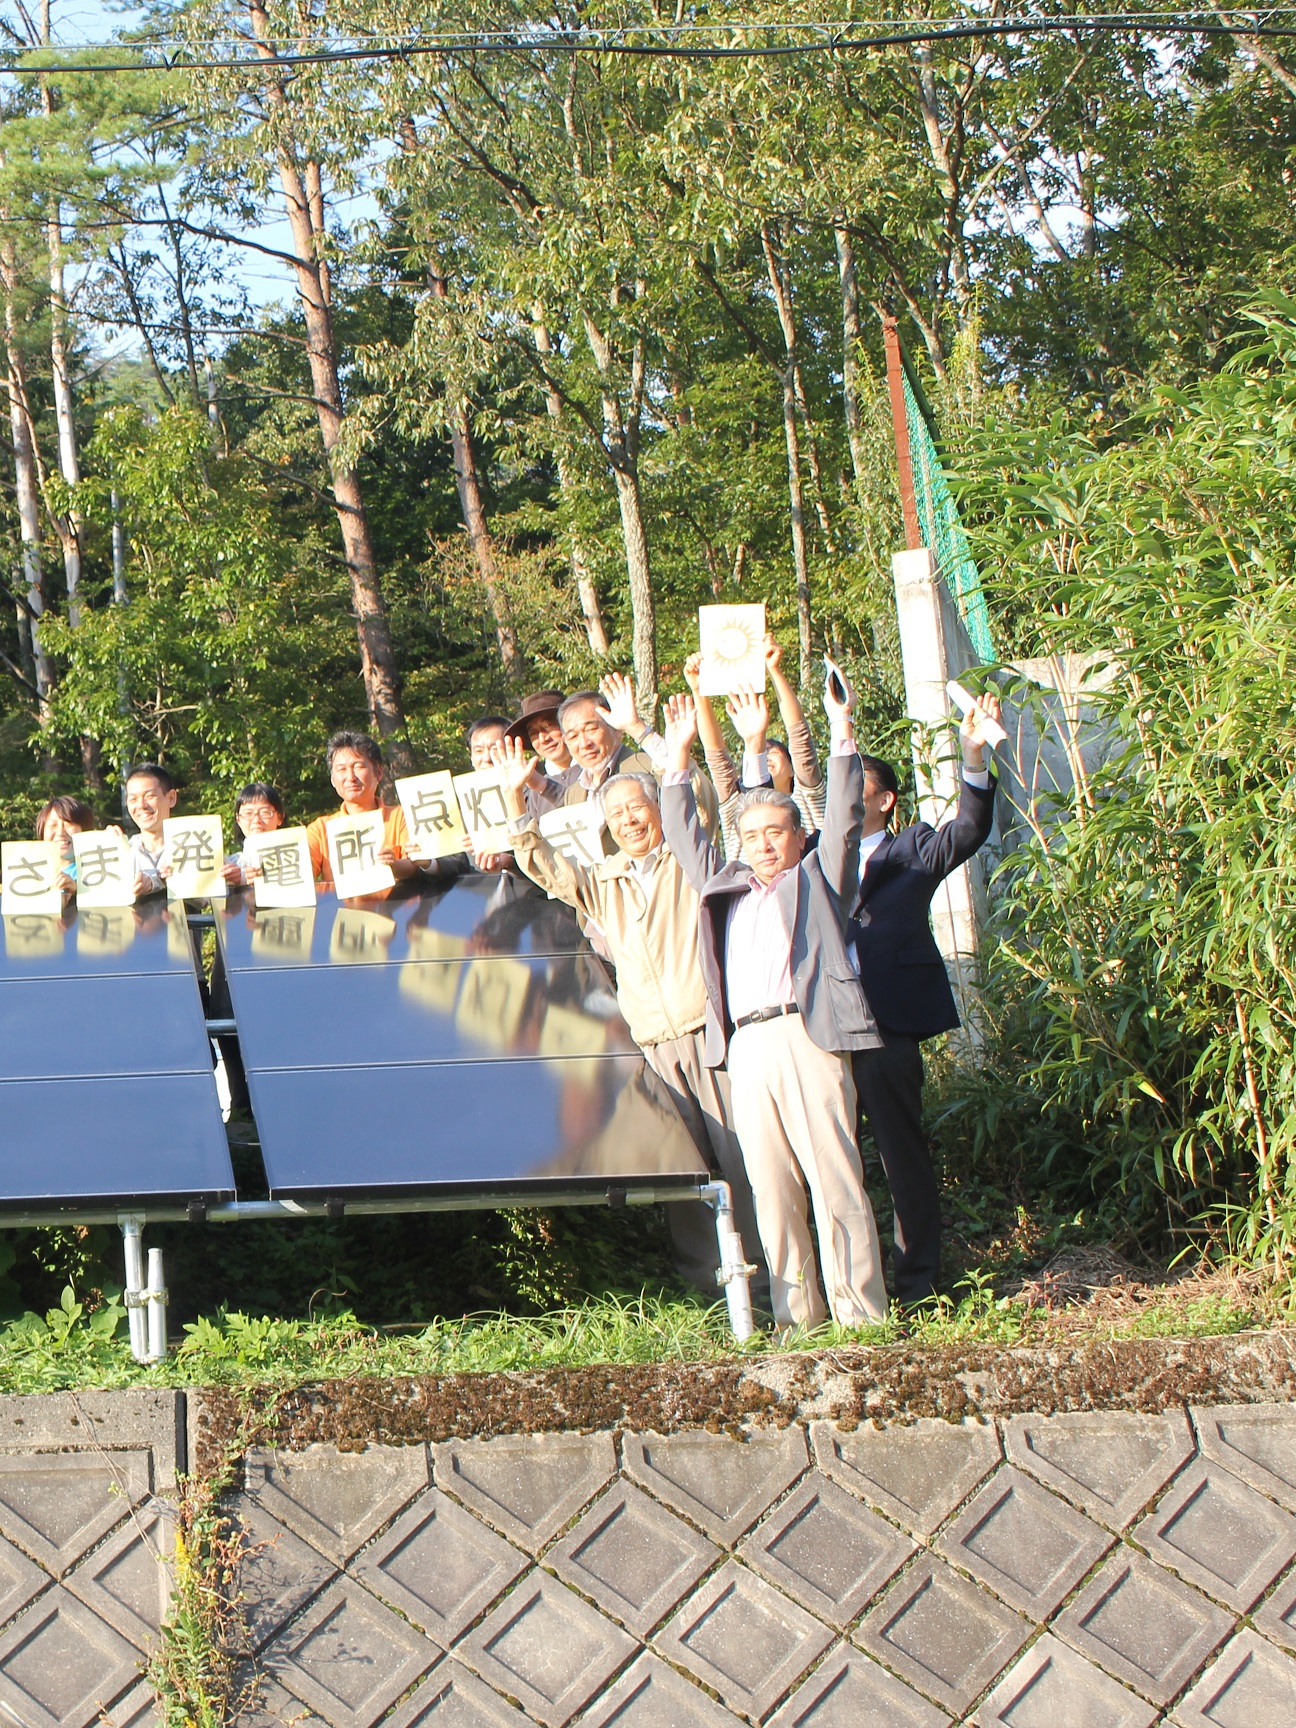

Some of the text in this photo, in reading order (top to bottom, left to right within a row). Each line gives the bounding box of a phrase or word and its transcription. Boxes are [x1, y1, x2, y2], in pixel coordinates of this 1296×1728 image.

[7, 856, 51, 897] さ
[81, 845, 120, 887] ま
[172, 830, 214, 873] 発
[257, 841, 304, 887] 電
[334, 828, 377, 875] 所
[410, 790, 454, 835] 点
